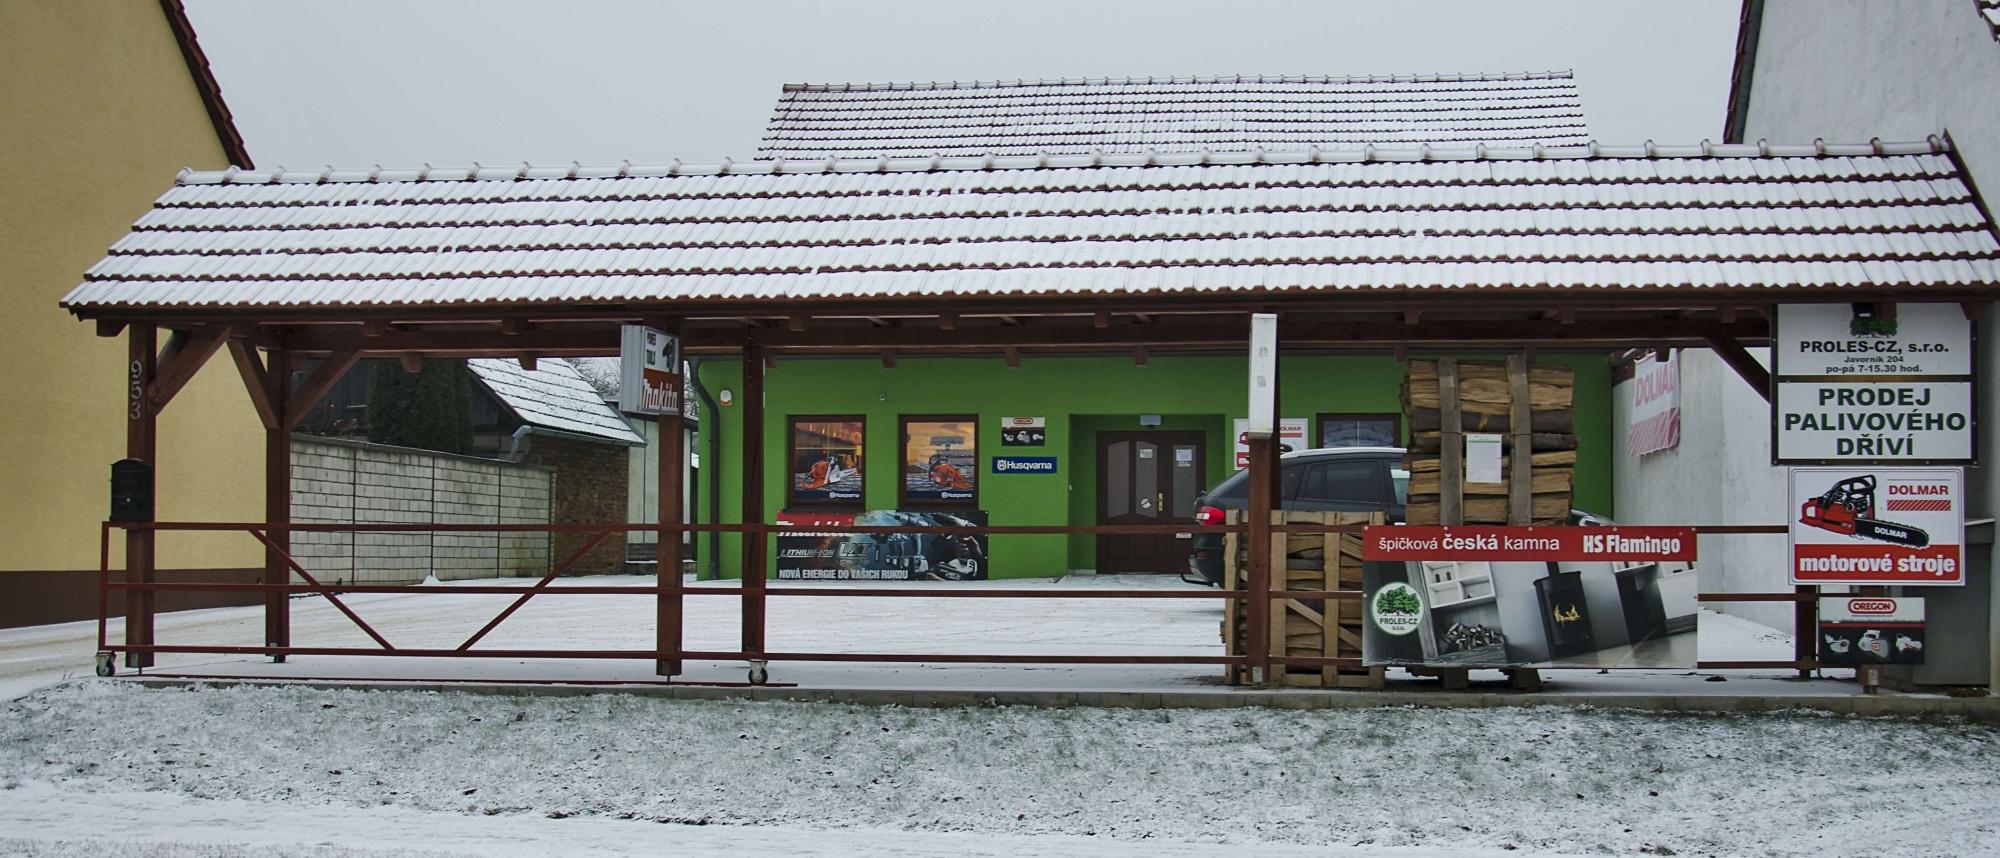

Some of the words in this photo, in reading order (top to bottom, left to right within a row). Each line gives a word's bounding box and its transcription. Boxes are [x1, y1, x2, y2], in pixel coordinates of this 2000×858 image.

[1800, 341, 1902, 355] PROLES-CZ,
[1908, 342, 1949, 353] s.r.o.
[1826, 365, 1855, 374] po-pá
[1858, 365, 1897, 373] 7-15.30
[1900, 365, 1923, 373] hod.
[130, 360, 143, 420] 953
[1819, 388, 1931, 406] PRODEJ
[1785, 409, 1966, 431] PALIVOVÉHO
[1837, 433, 1914, 456] DŘÍVÍ
[1006, 460, 1053, 470] Husqvarna
[1889, 485, 1949, 495] DOLMAR
[1874, 526, 1907, 539] DOLMAR
[1378, 537, 1438, 550] špičková
[1442, 534, 1498, 550] česká
[1504, 536, 1560, 550] kamna
[1583, 535, 1604, 553] HS
[1606, 535, 1681, 554] Flamingo
[1800, 554, 1893, 573] motorové
[1897, 554, 1956, 576] stroje
[779, 567, 801, 579] NOVÁ
[802, 569, 836, 579] ENERGIE
[838, 569, 849, 579] DO
[851, 567, 880, 579] VAŠICH
[881, 569, 909, 579] RUKOU
[1853, 602, 1891, 610] OREGON
